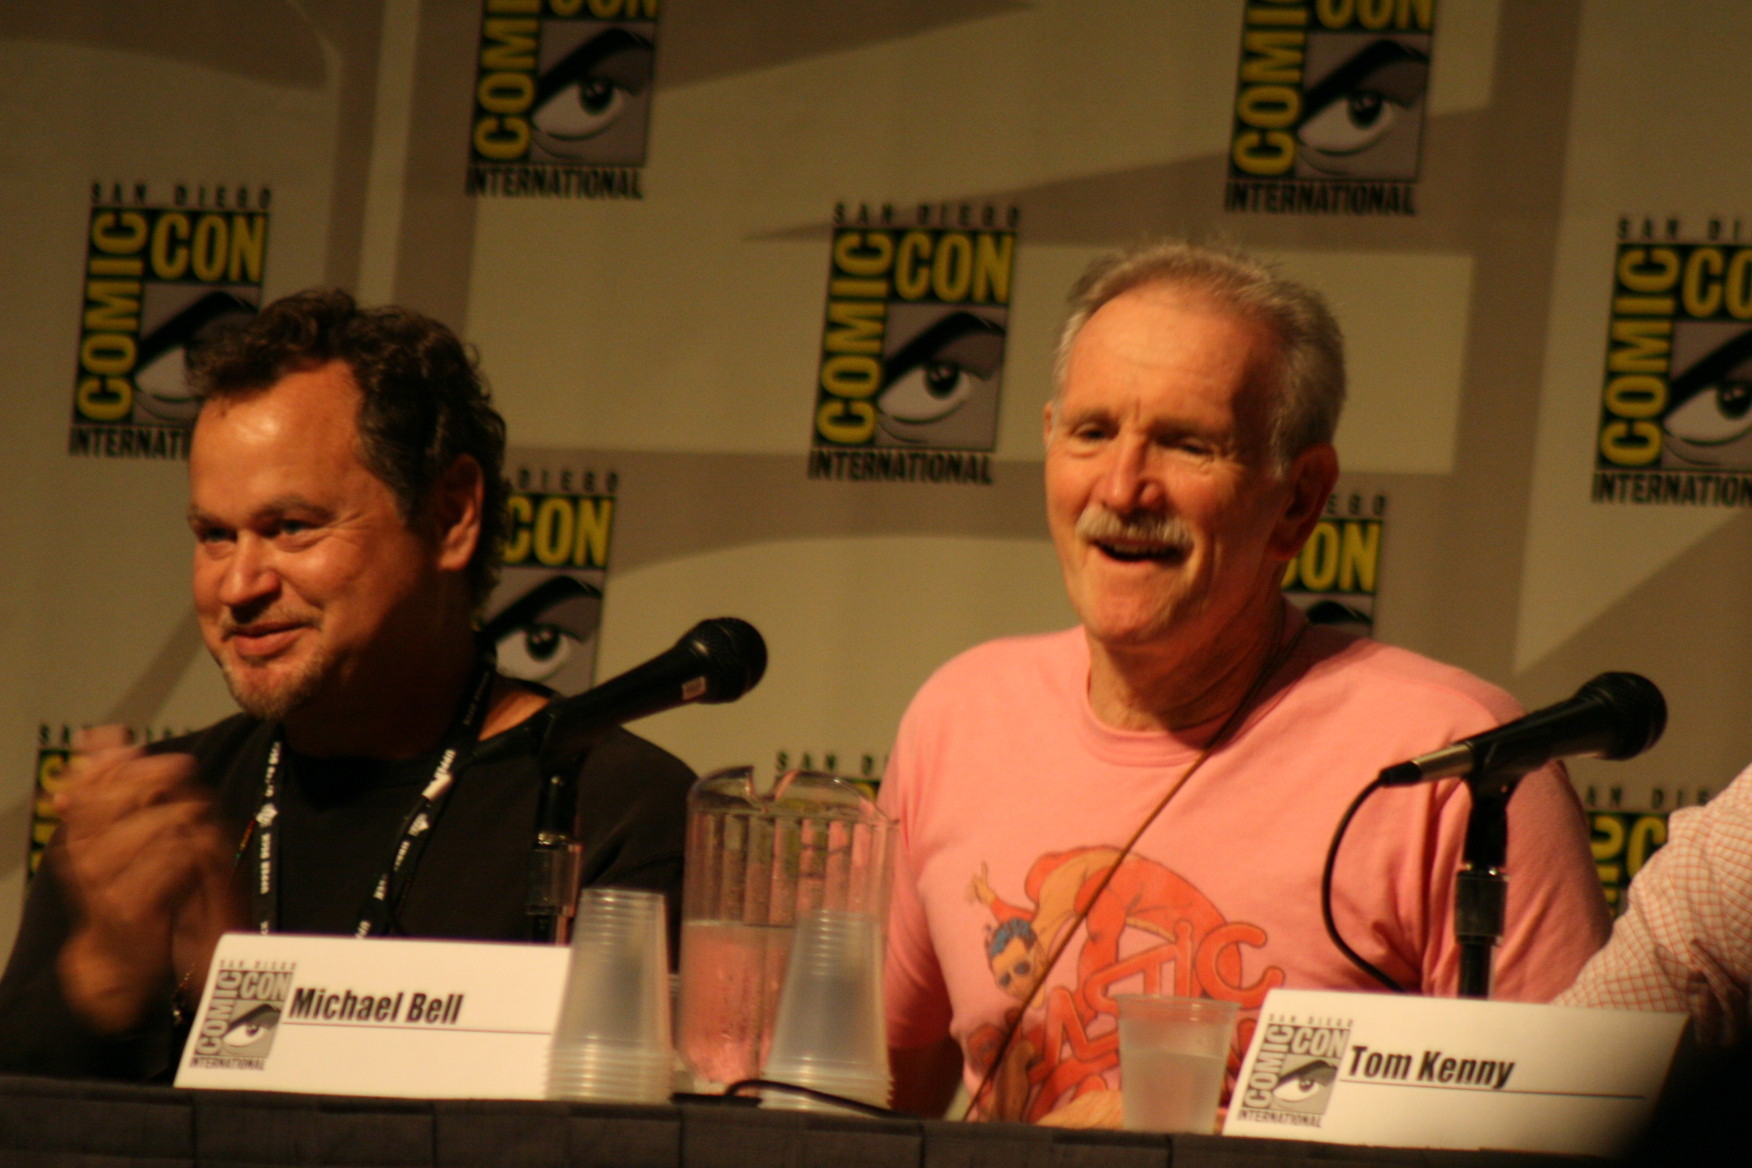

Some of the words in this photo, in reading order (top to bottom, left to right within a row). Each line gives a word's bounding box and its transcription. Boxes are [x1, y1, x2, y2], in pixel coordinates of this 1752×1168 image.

[472, 0, 542, 160] COMI
[1232, 0, 1308, 175] COMI
[91, 183, 147, 206] SAN
[175, 186, 271, 208] DIEGO
[465, 168, 644, 200] INTERNATIONAL
[1224, 182, 1415, 216] INTERNATIONAL
[833, 202, 893, 226] SAN
[917, 204, 1020, 228] DIEGO
[1617, 217, 1678, 240] SAN
[150, 212, 267, 283] CON
[895, 231, 1016, 304] CON
[1682, 248, 1752, 320] CO
[76, 211, 149, 421] COMIC
[815, 231, 895, 445] COMIC
[1601, 247, 1681, 467] COMIC
[517, 468, 619, 492] DIEGO
[807, 450, 994, 486] INTERNATIONAL
[502, 495, 614, 567] CON
[1281, 521, 1381, 593] ON
[775, 750, 836, 773] SAN
[1585, 785, 1623, 806] AN
[241, 971, 293, 1002] CON
[288, 986, 404, 1023] Michael
[405, 992, 464, 1024] Bell
[195, 971, 243, 1056] COMIC
[1291, 1026, 1351, 1060] CON
[188, 1056, 266, 1071] INTERNATIONAL
[1242, 1025, 1294, 1110] COMIC
[1349, 1045, 1412, 1080] Tom
[1416, 1050, 1515, 1090] Kenny
[1237, 1110, 1322, 1129] INTERNATIONAL
